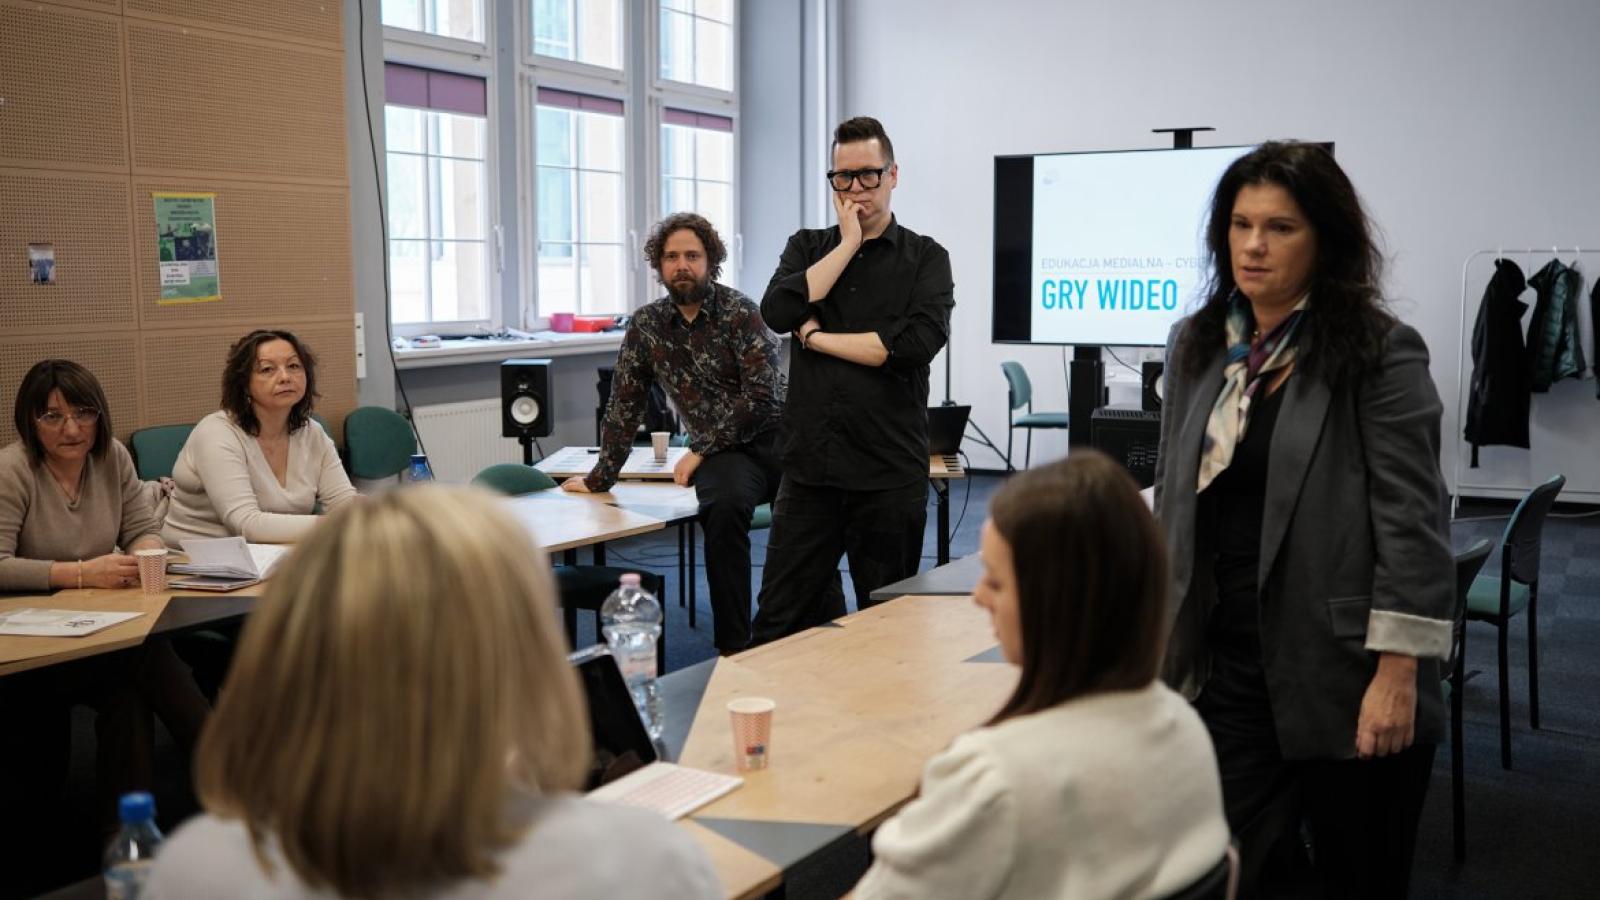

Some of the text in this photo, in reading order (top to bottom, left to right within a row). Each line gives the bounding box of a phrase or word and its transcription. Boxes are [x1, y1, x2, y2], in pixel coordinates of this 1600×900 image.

[1042, 257, 1100, 269] EDUKACJA
[1103, 257, 1163, 269] MEDIALNA
[1042, 280, 1178, 310] GRY WIDEO
